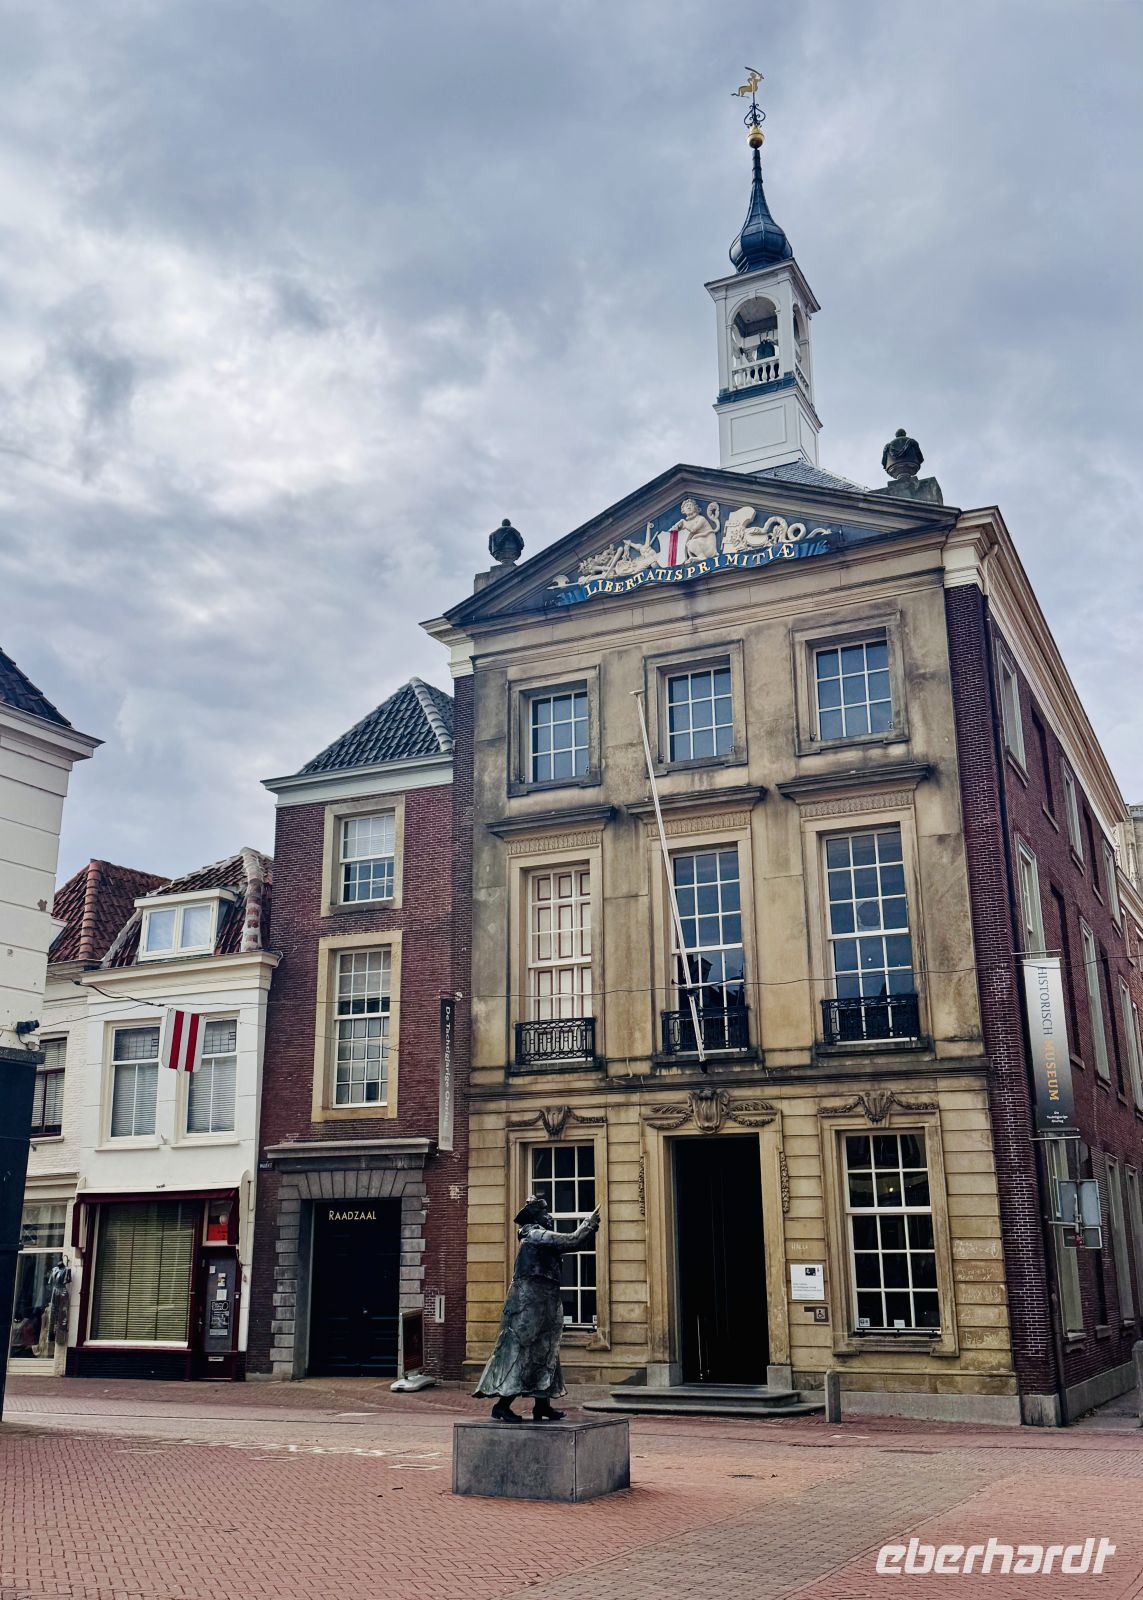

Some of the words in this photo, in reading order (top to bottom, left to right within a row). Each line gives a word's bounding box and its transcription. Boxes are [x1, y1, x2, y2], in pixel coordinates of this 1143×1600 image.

[445, 1006, 451, 1021] De
[1037, 966, 1053, 1035] HISTORISCH
[1044, 1040, 1059, 1101] MUSEUM
[328, 1210, 377, 1220] RAADZAAL
